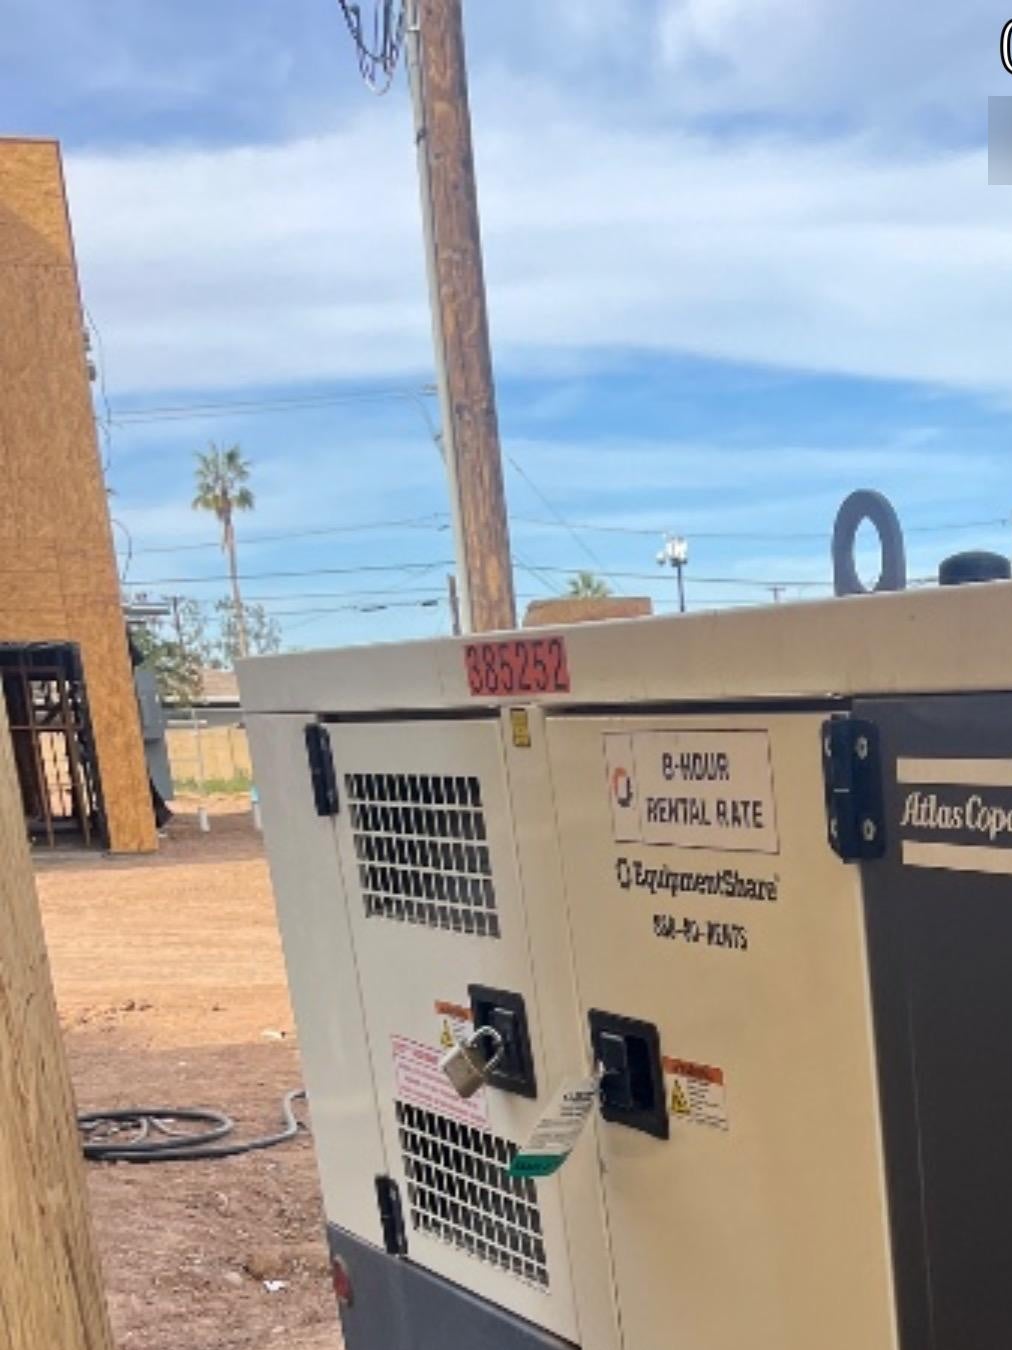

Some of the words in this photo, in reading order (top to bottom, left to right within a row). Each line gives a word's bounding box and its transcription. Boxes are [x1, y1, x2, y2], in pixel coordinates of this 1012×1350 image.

[466, 638, 567, 694] 385252
[661, 752, 731, 782] 8-HOUR
[646, 797, 712, 826] RENTAL
[716, 799, 764, 829] RATE
[899, 791, 963, 829] Atlas
[632, 860, 778, 901] EquipmentShare
